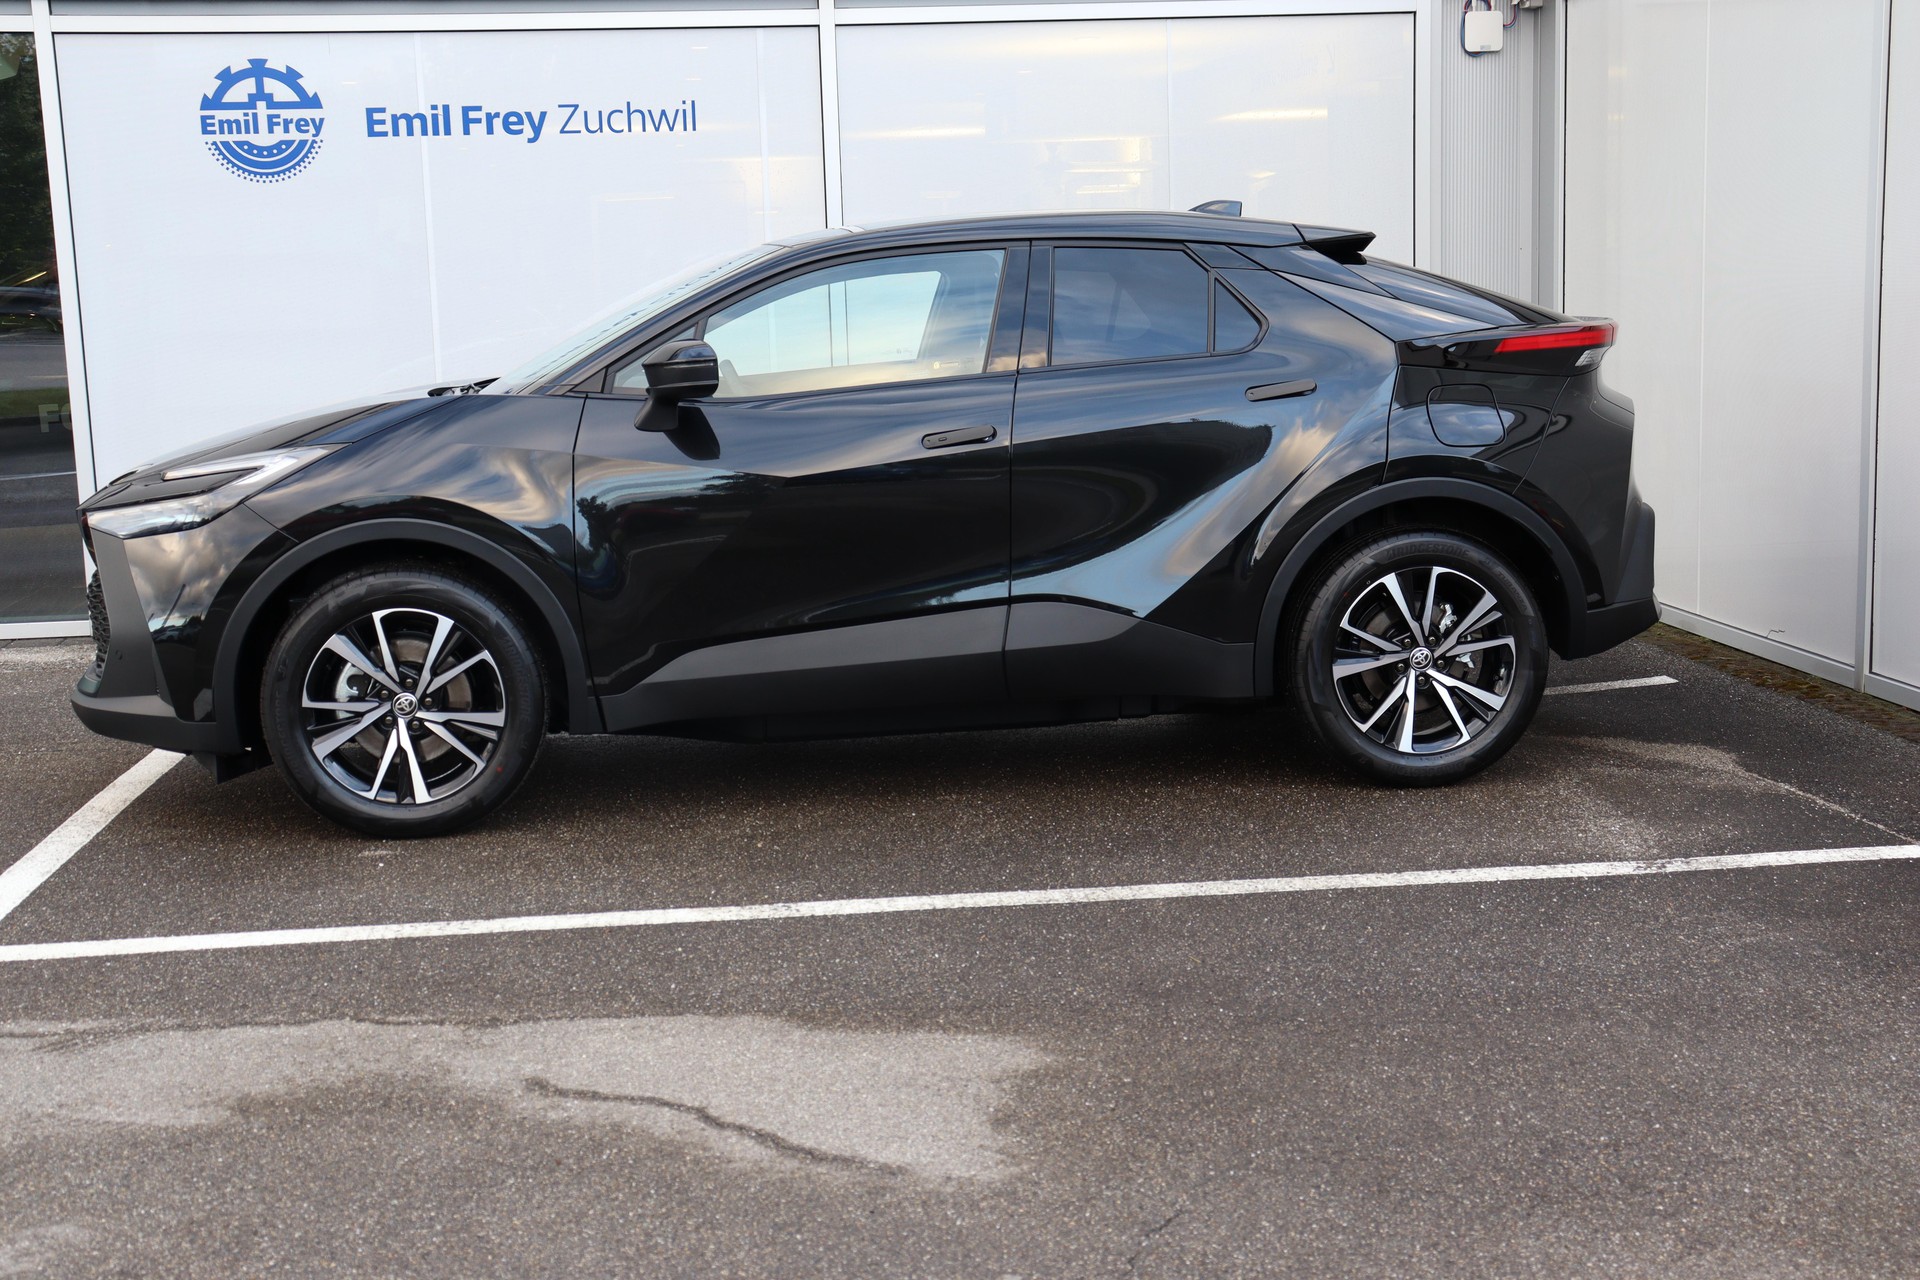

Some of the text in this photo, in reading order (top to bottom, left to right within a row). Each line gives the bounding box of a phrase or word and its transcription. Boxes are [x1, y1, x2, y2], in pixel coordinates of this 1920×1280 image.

[200, 112, 325, 139] Emil Frey
[365, 100, 697, 144] Emil Frey Zuchwil
